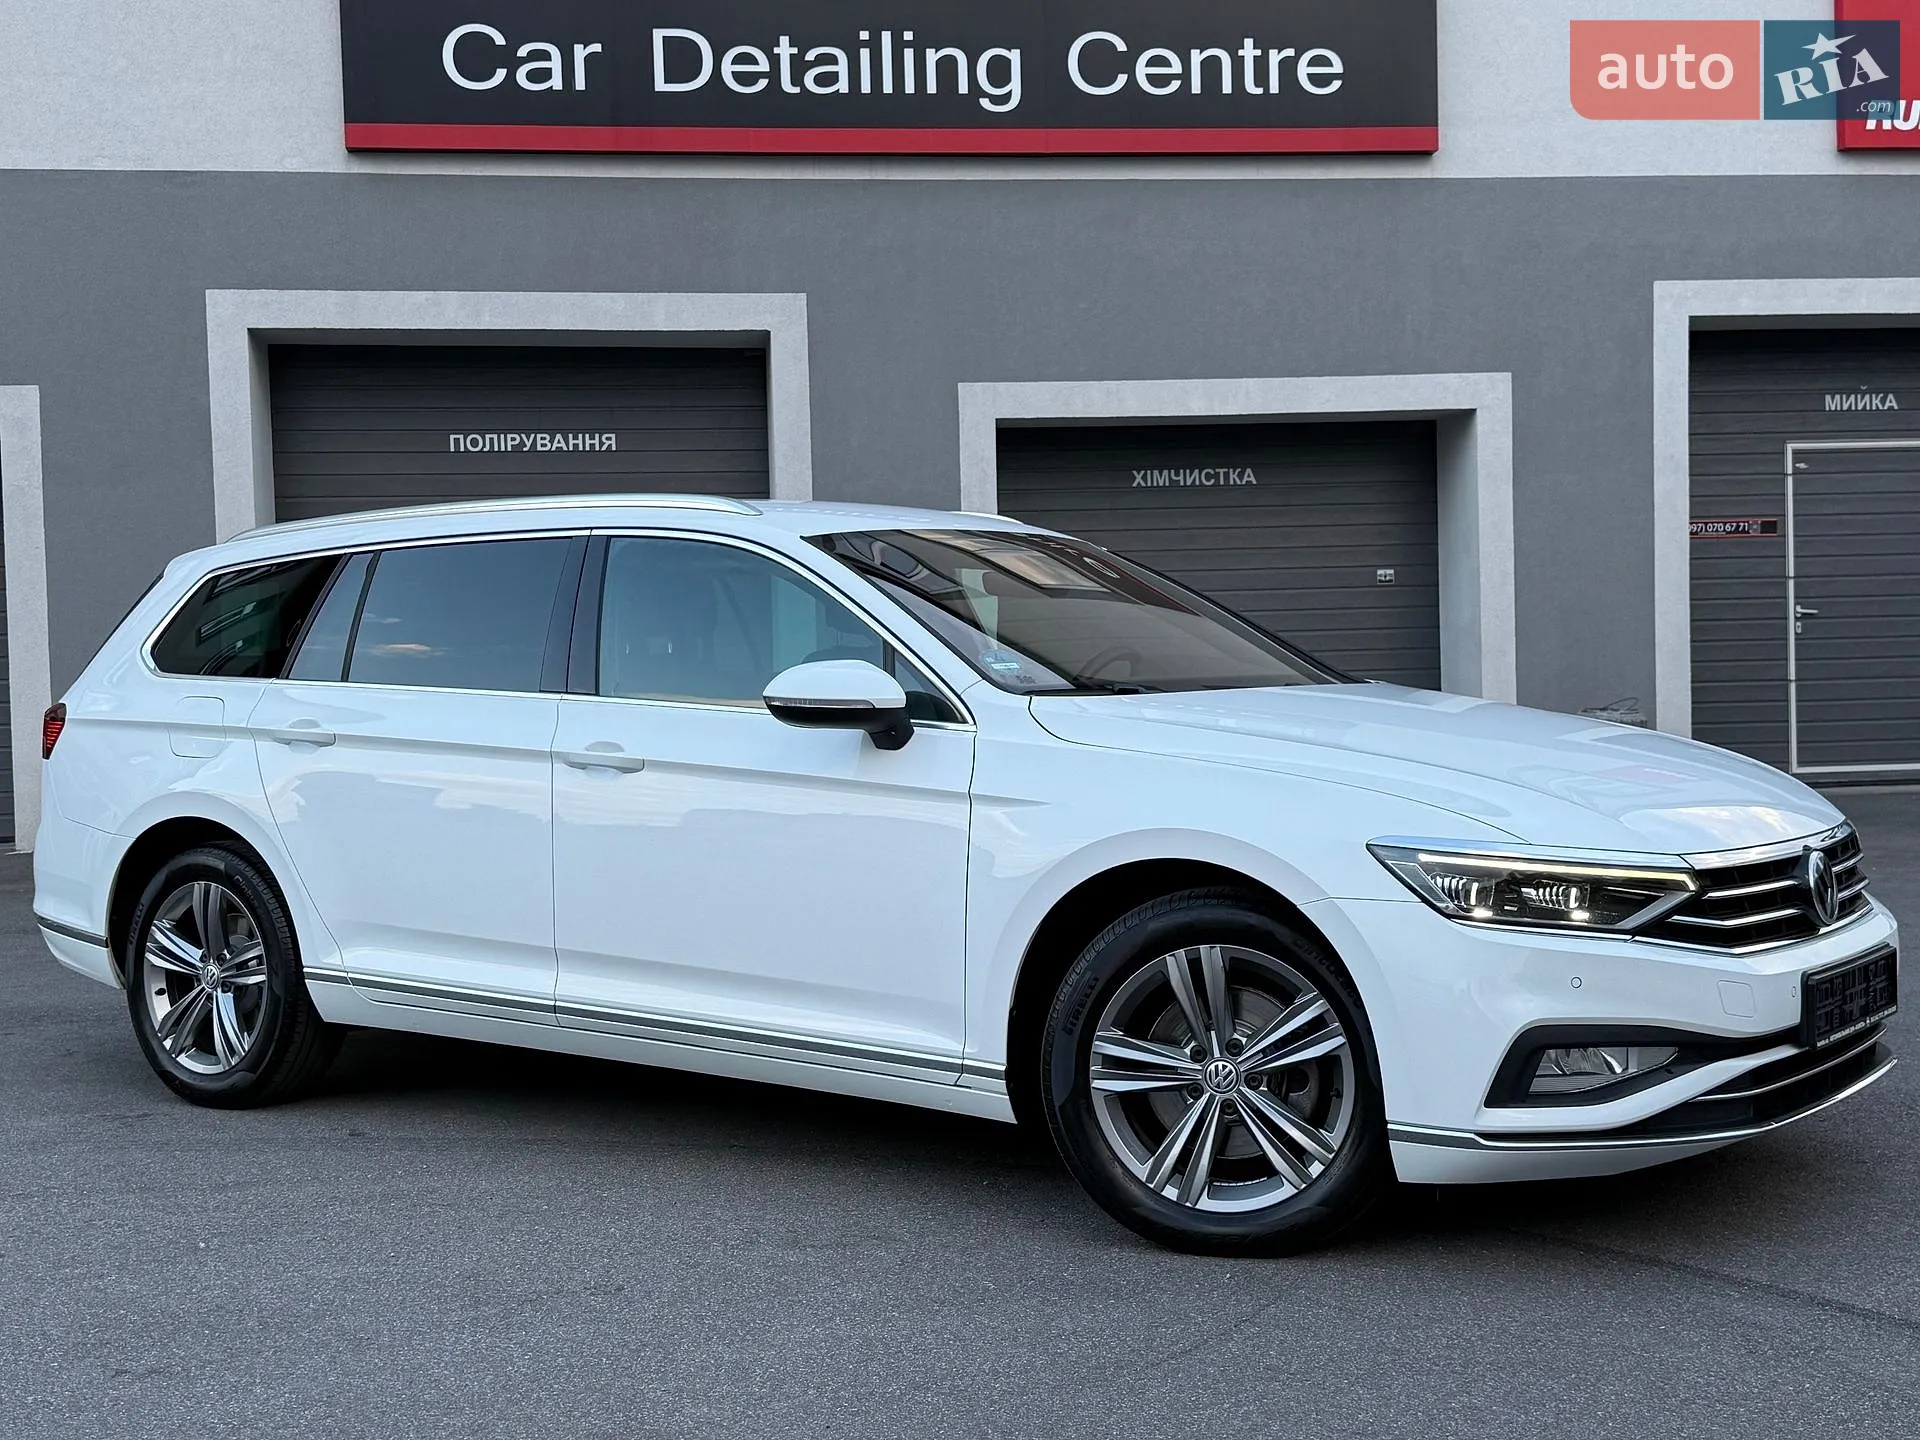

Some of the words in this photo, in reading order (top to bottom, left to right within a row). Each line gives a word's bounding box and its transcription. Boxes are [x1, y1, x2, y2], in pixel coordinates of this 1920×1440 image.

[442, 23, 602, 91] Car
[652, 28, 1022, 113] Detailing
[1067, 30, 1344, 96] Centre
[1865, 99, 1920, 131] RU
[1825, 385, 1899, 411] МИЙКА
[449, 433, 617, 452] ПОЛІРУВАННЯ
[1132, 468, 1257, 487] ХІМЧИСТКА
[1706, 523, 1724, 532] 070
[1725, 522, 1738, 532] 67
[1738, 522, 1749, 532] 71
